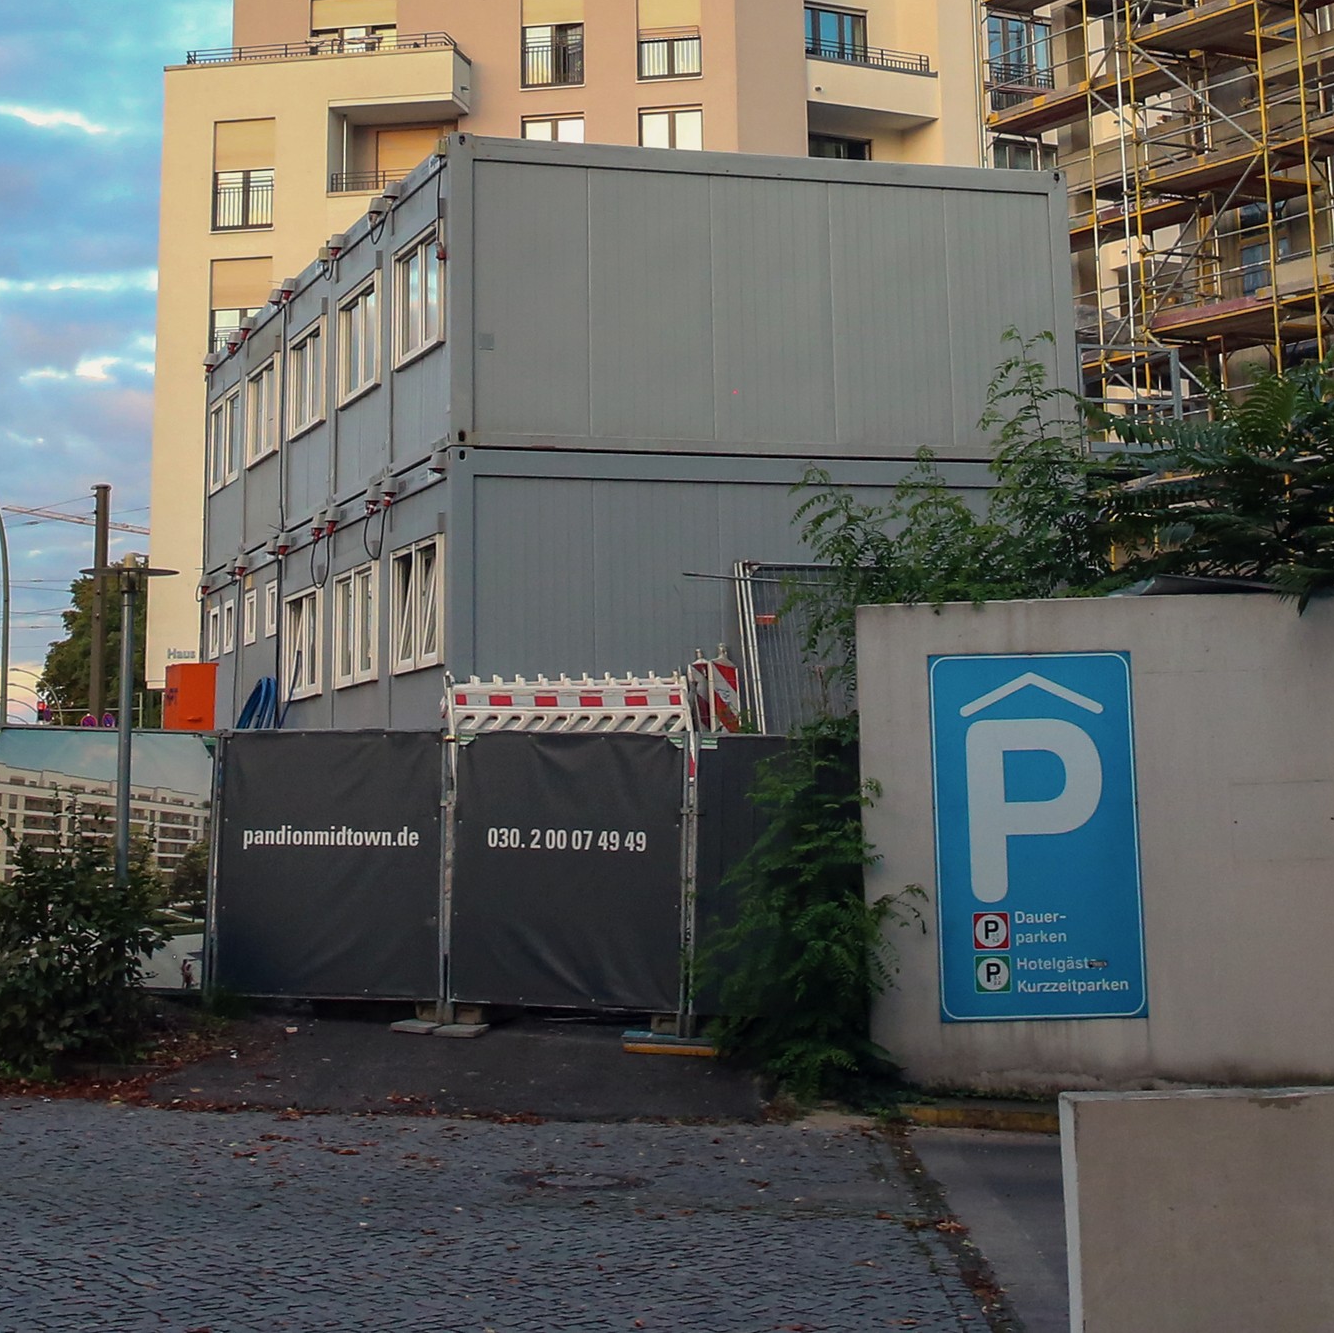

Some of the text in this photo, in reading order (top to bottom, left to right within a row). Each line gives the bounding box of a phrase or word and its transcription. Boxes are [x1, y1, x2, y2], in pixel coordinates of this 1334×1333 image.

[167, 648, 196, 659] Haus
[965, 718, 1103, 903] P
[243, 825, 419, 849] pandionmidtown.de
[487, 827, 647, 852] 030. 2 00 07 49 49
[1014, 911, 1067, 924] Dauer-
[1016, 930, 1067, 946] parken
[1017, 978, 1129, 995] Kurzzeitparken
